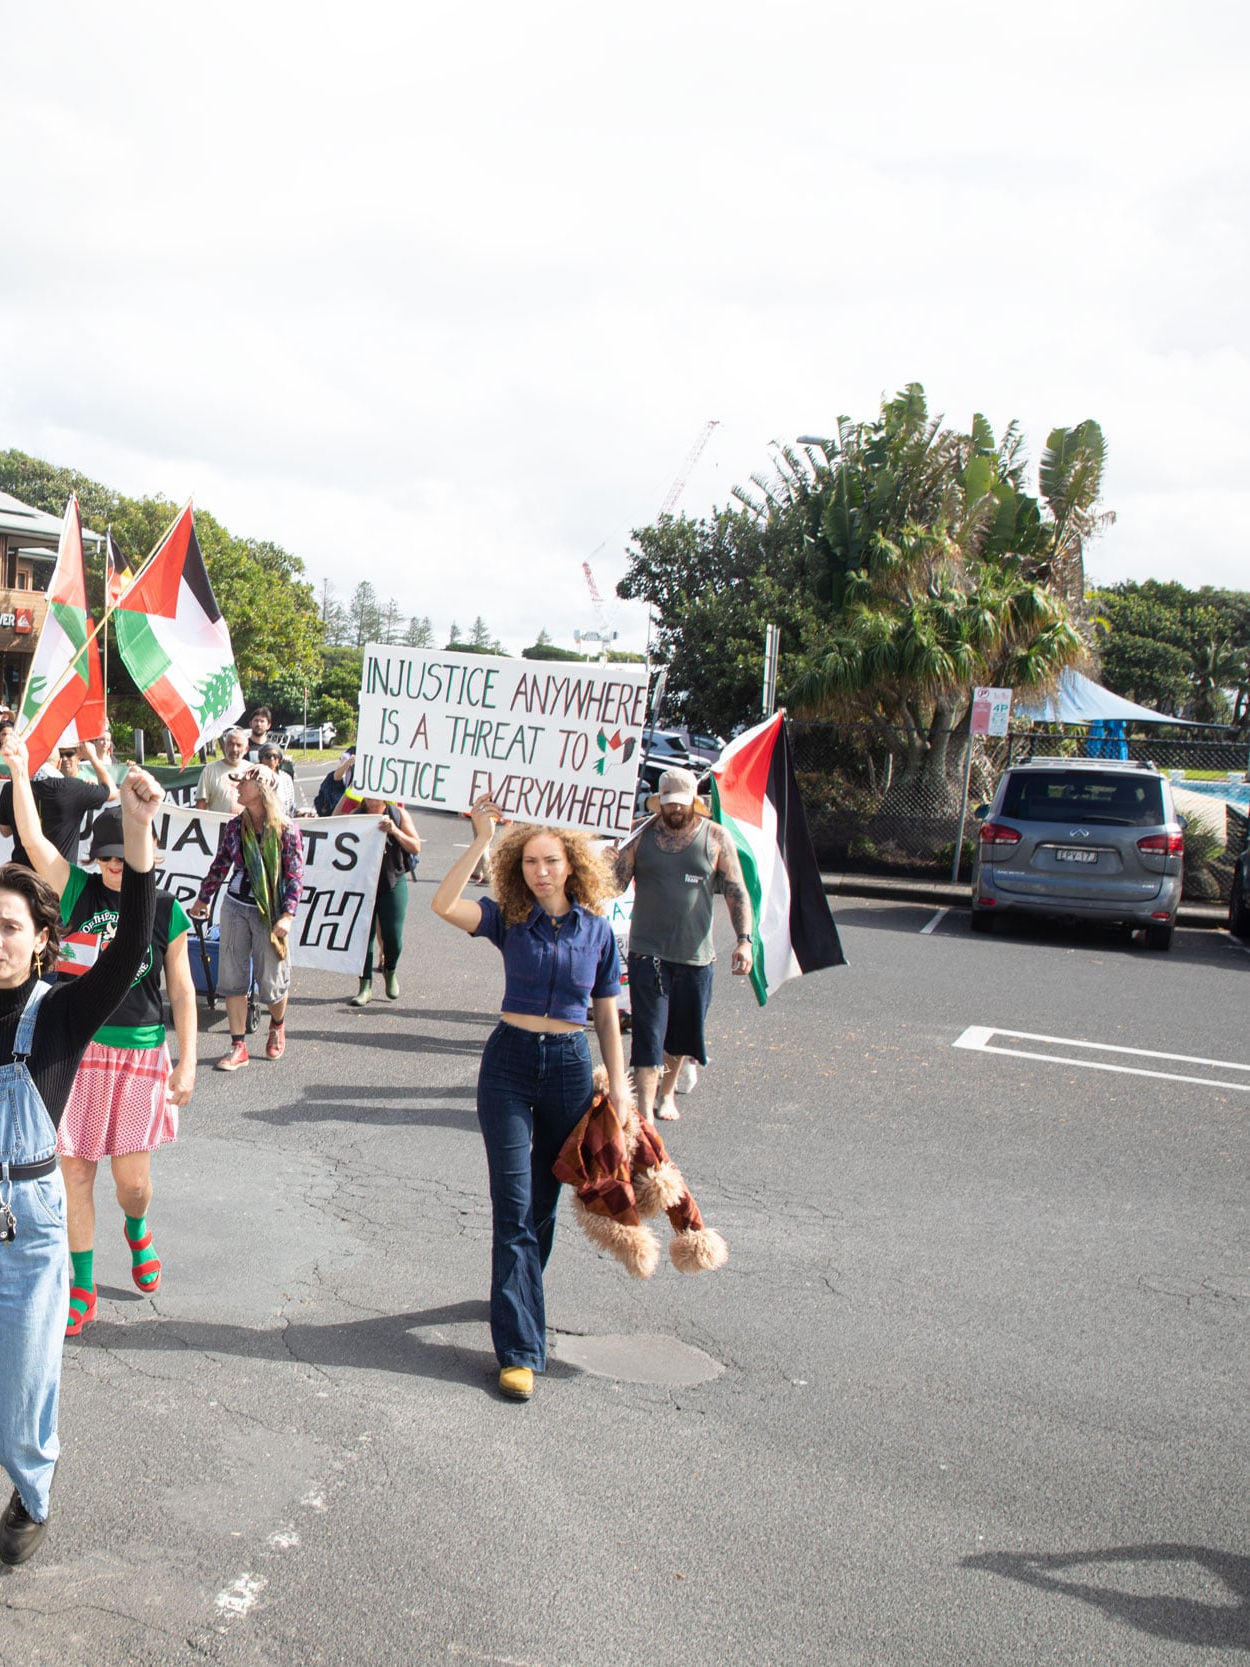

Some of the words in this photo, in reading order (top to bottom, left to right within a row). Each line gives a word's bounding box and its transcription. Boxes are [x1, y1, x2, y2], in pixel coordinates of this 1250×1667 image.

[366, 657, 499, 709] INJUSTICE
[510, 672, 647, 727] ANYWHERE
[378, 708, 399, 745] IS
[410, 713, 428, 749] A
[446, 715, 545, 764] THREAT
[558, 729, 589, 771] TO
[353, 754, 450, 802] JUSTICE
[469, 769, 634, 831] EVERYWHERE
